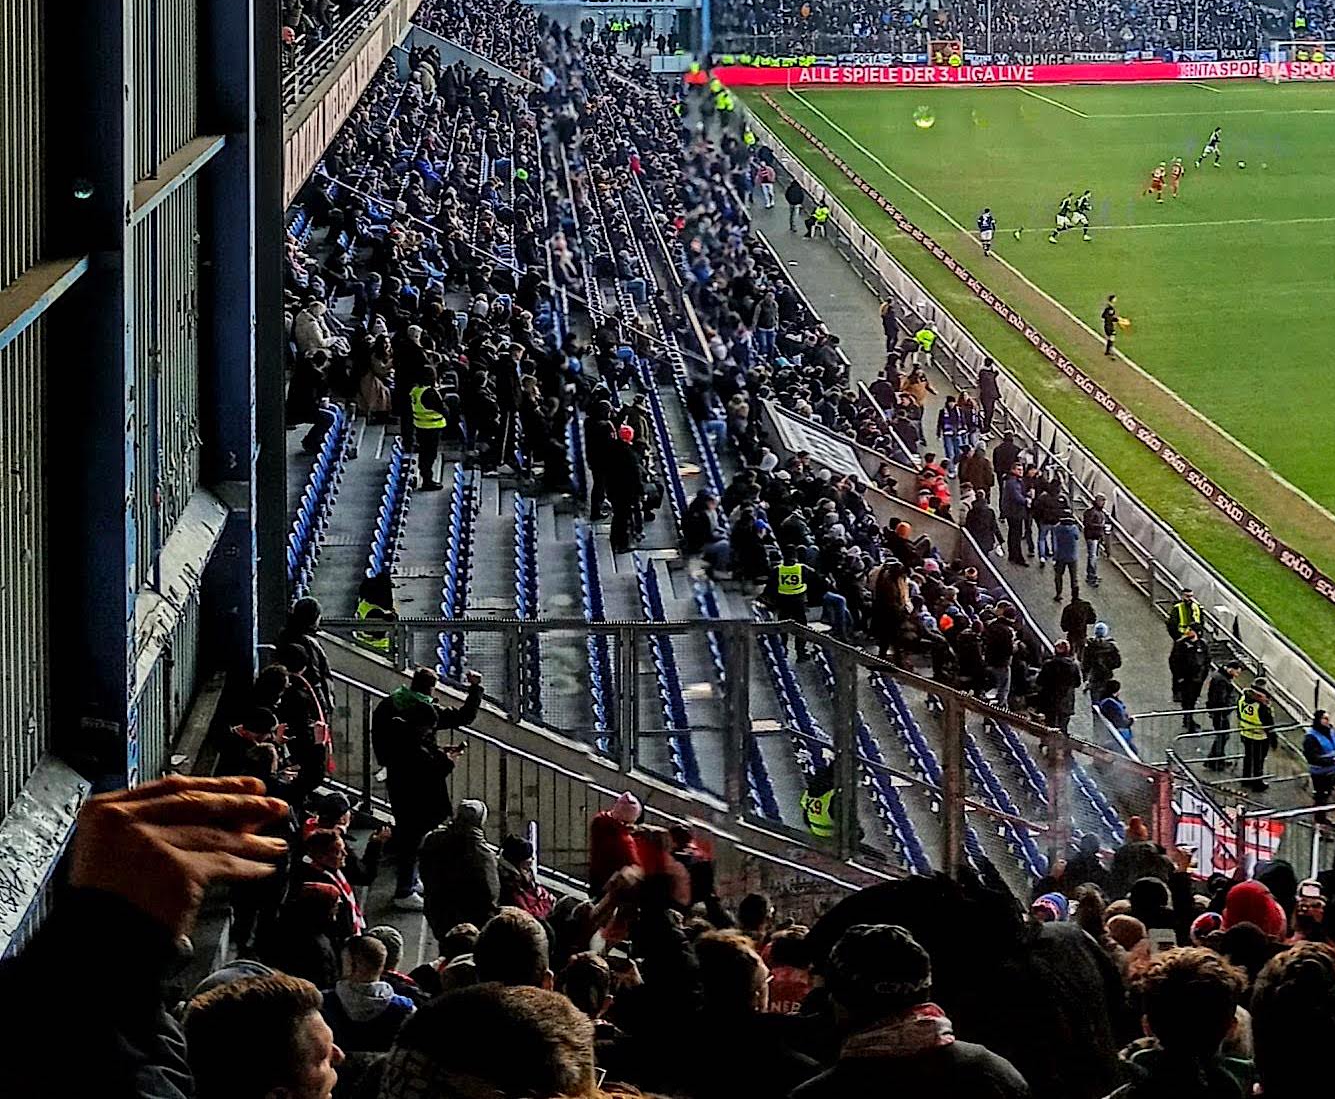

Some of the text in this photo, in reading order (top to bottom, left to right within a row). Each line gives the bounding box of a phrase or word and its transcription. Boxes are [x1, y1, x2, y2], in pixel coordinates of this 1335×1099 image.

[800, 65, 1034, 83] ALLE SPIELE DER 3. LIGA LIVE
[780, 574, 800, 586] K9
[1241, 703, 1254, 716] K9
[806, 797, 823, 815] K9
